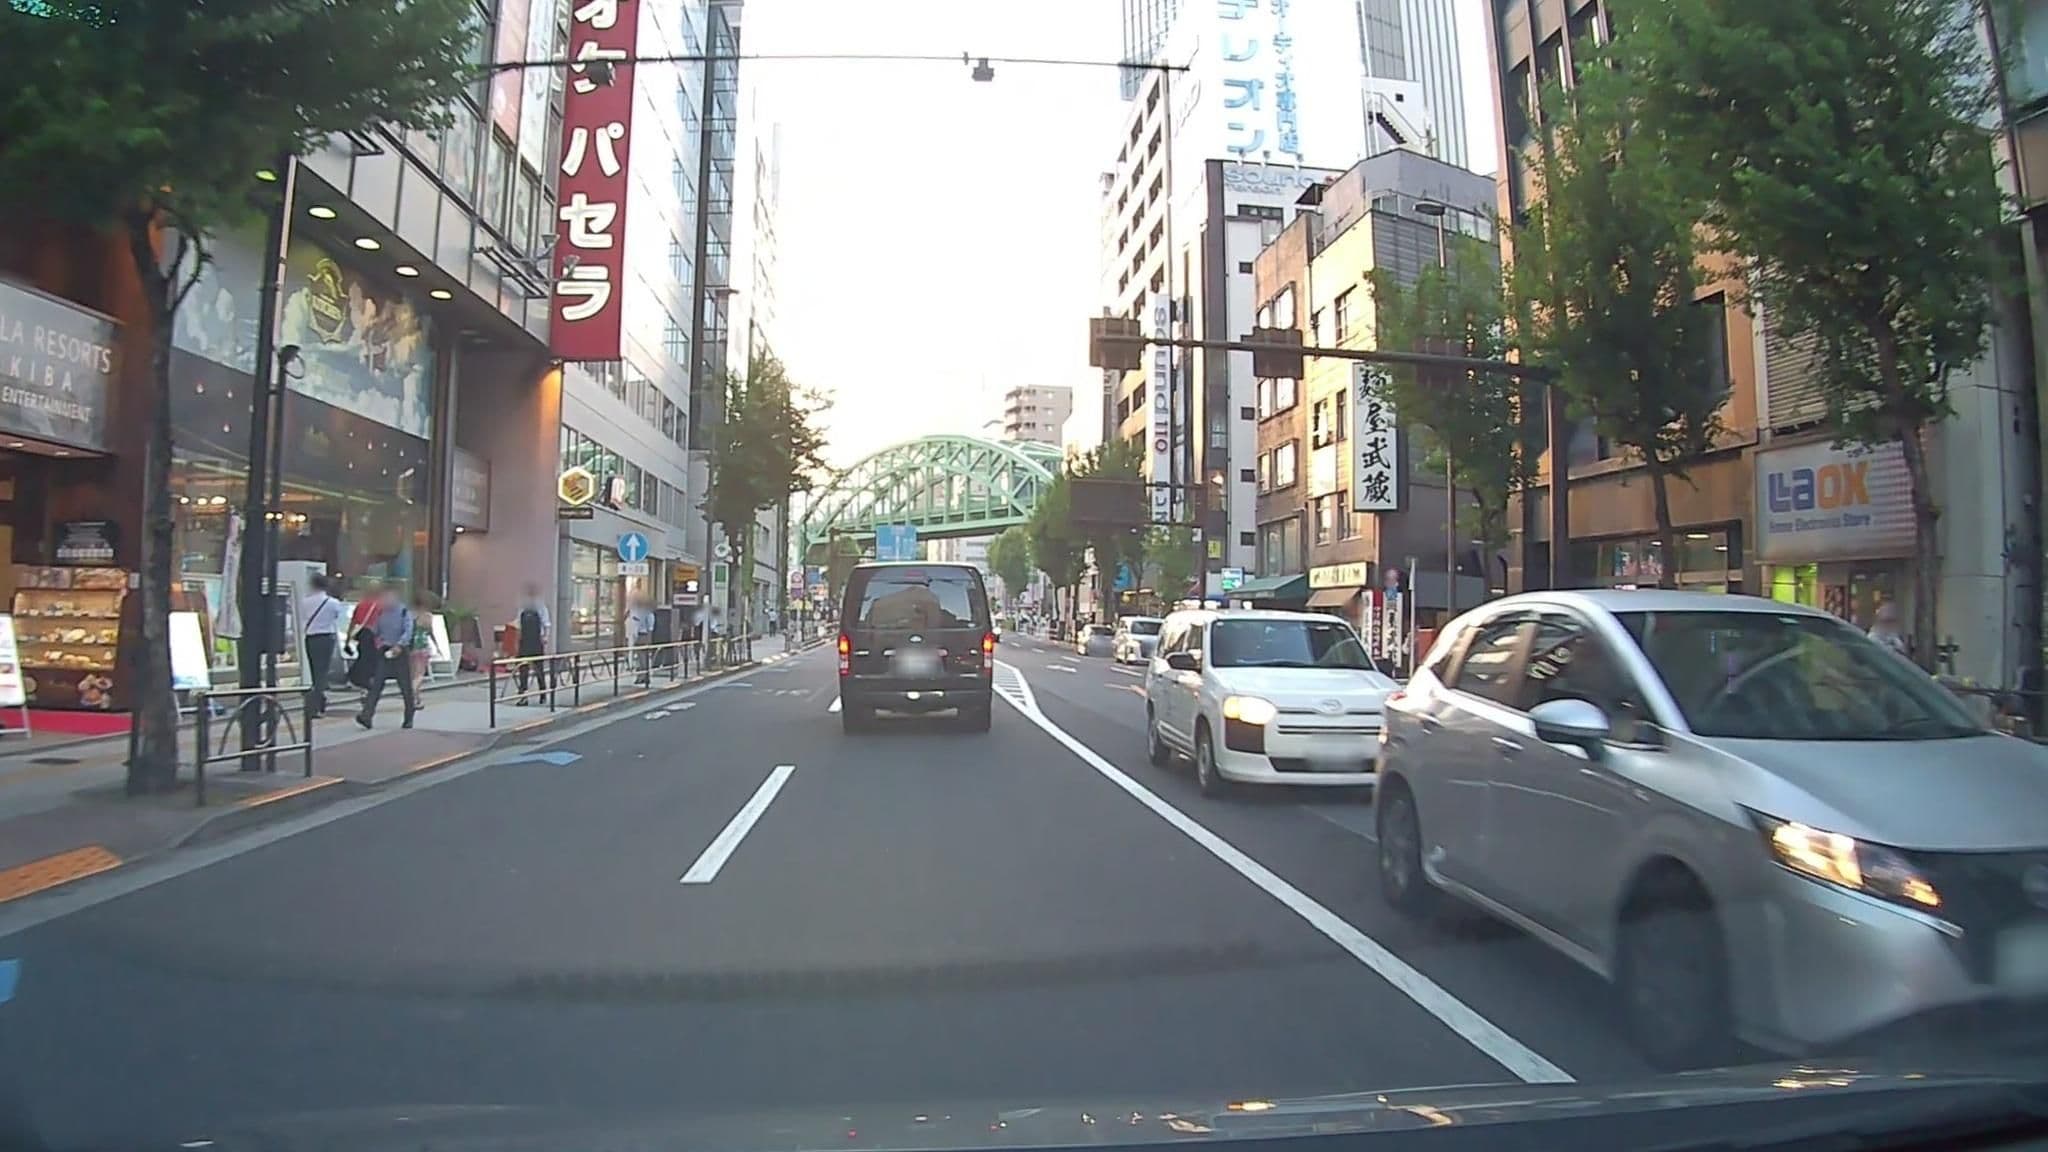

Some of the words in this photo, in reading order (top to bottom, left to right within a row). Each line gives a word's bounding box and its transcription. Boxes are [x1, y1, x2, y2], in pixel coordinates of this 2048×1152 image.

[34, 325, 112, 374] RESORTS
[1, 385, 92, 424] ENTERTAINMENT
[1359, 363, 1391, 504] 麺屋武蔵
